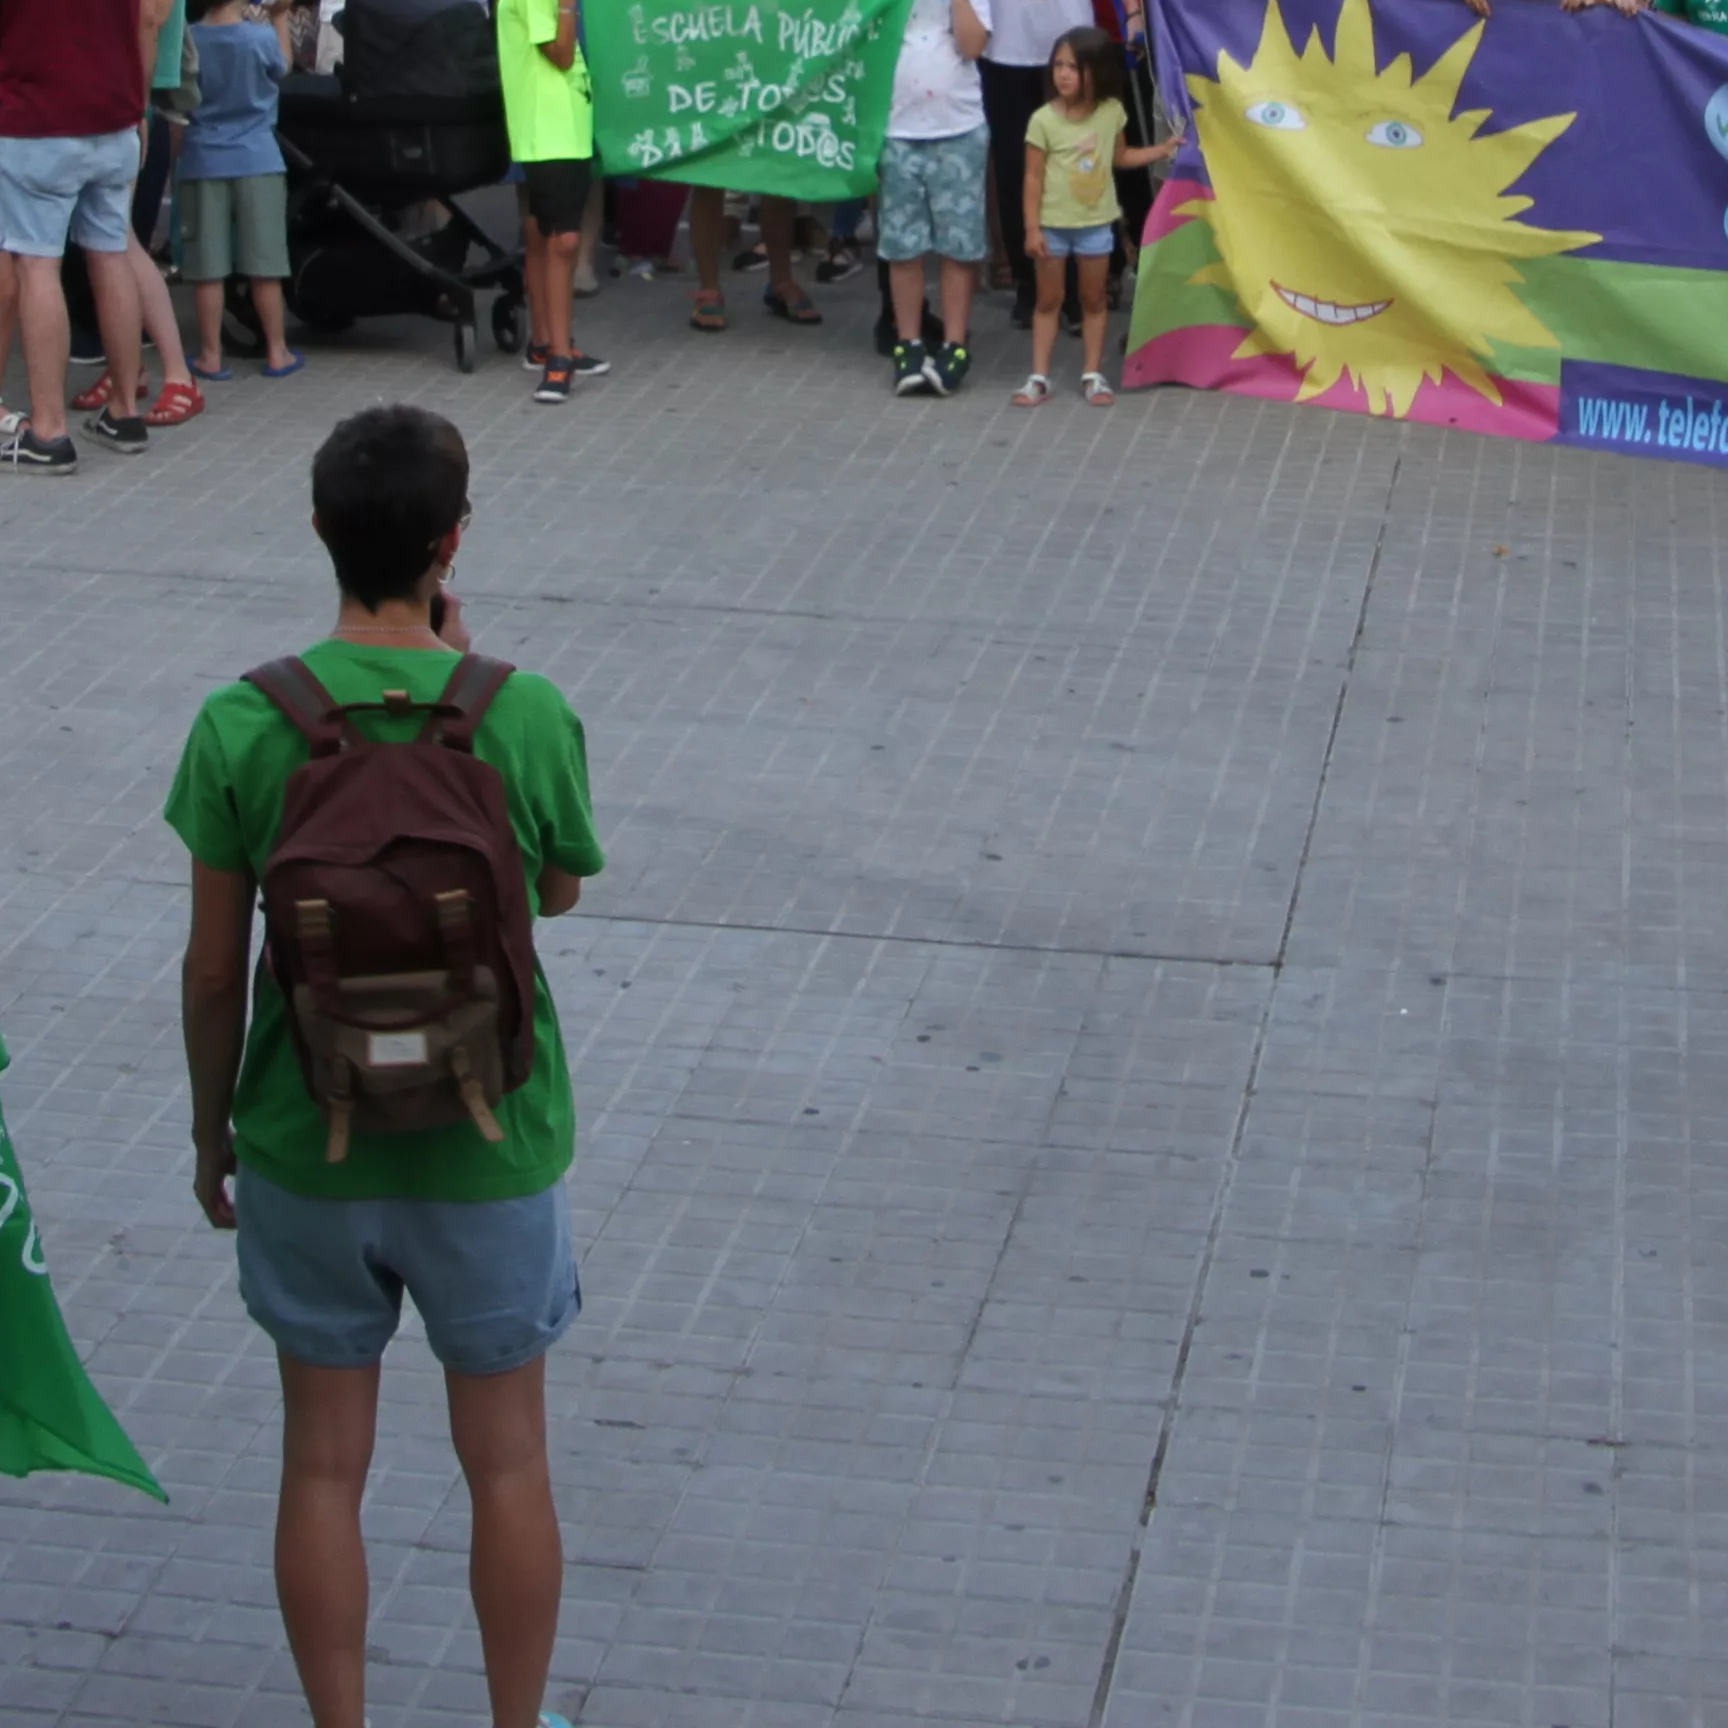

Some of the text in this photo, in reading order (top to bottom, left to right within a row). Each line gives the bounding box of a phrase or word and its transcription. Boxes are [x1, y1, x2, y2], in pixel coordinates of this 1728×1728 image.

[632, 4, 879, 60] ESCUELA PÚBLI
[667, 74, 846, 114] DE TOS
